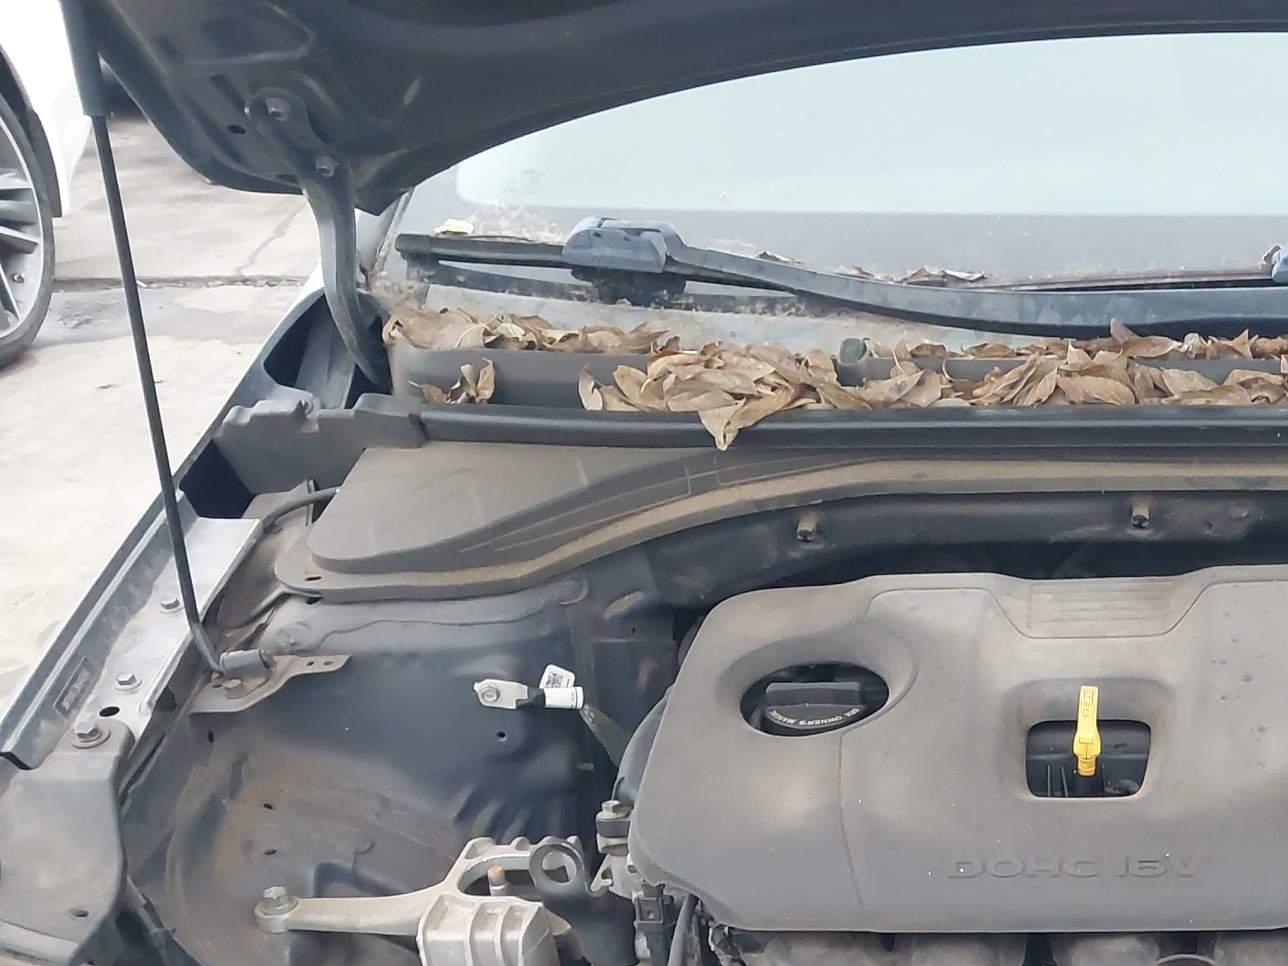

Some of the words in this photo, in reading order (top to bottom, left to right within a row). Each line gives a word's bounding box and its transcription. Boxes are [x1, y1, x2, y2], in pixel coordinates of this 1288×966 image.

[798, 715, 843, 725] OWNER'S
[947, 858, 1100, 879] DOHC
[1117, 856, 1204, 879] 16V
